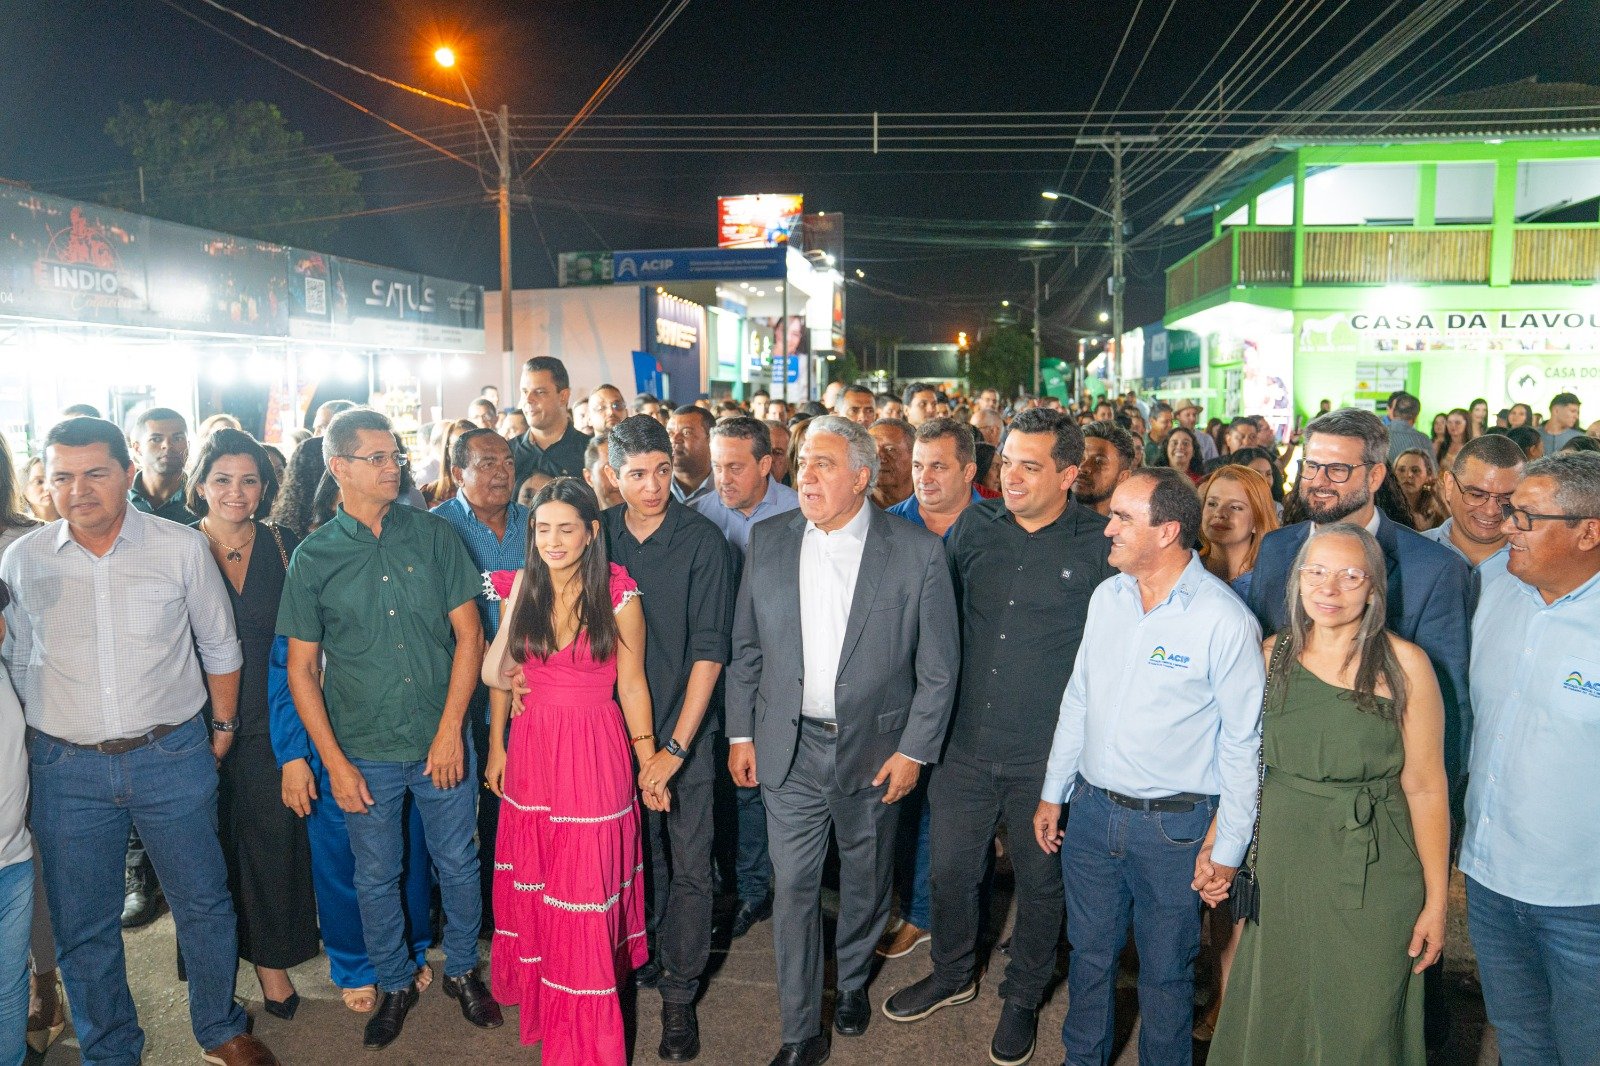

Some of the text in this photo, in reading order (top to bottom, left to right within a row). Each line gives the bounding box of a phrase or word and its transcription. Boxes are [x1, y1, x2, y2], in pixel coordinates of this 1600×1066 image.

[641, 259, 673, 271] ACIP
[53, 266, 118, 293] INDIO
[1351, 314, 1434, 329] CASA
[1448, 314, 1487, 328] DA
[1545, 367, 1576, 378] CASA
[1167, 653, 1190, 663] ACIP
